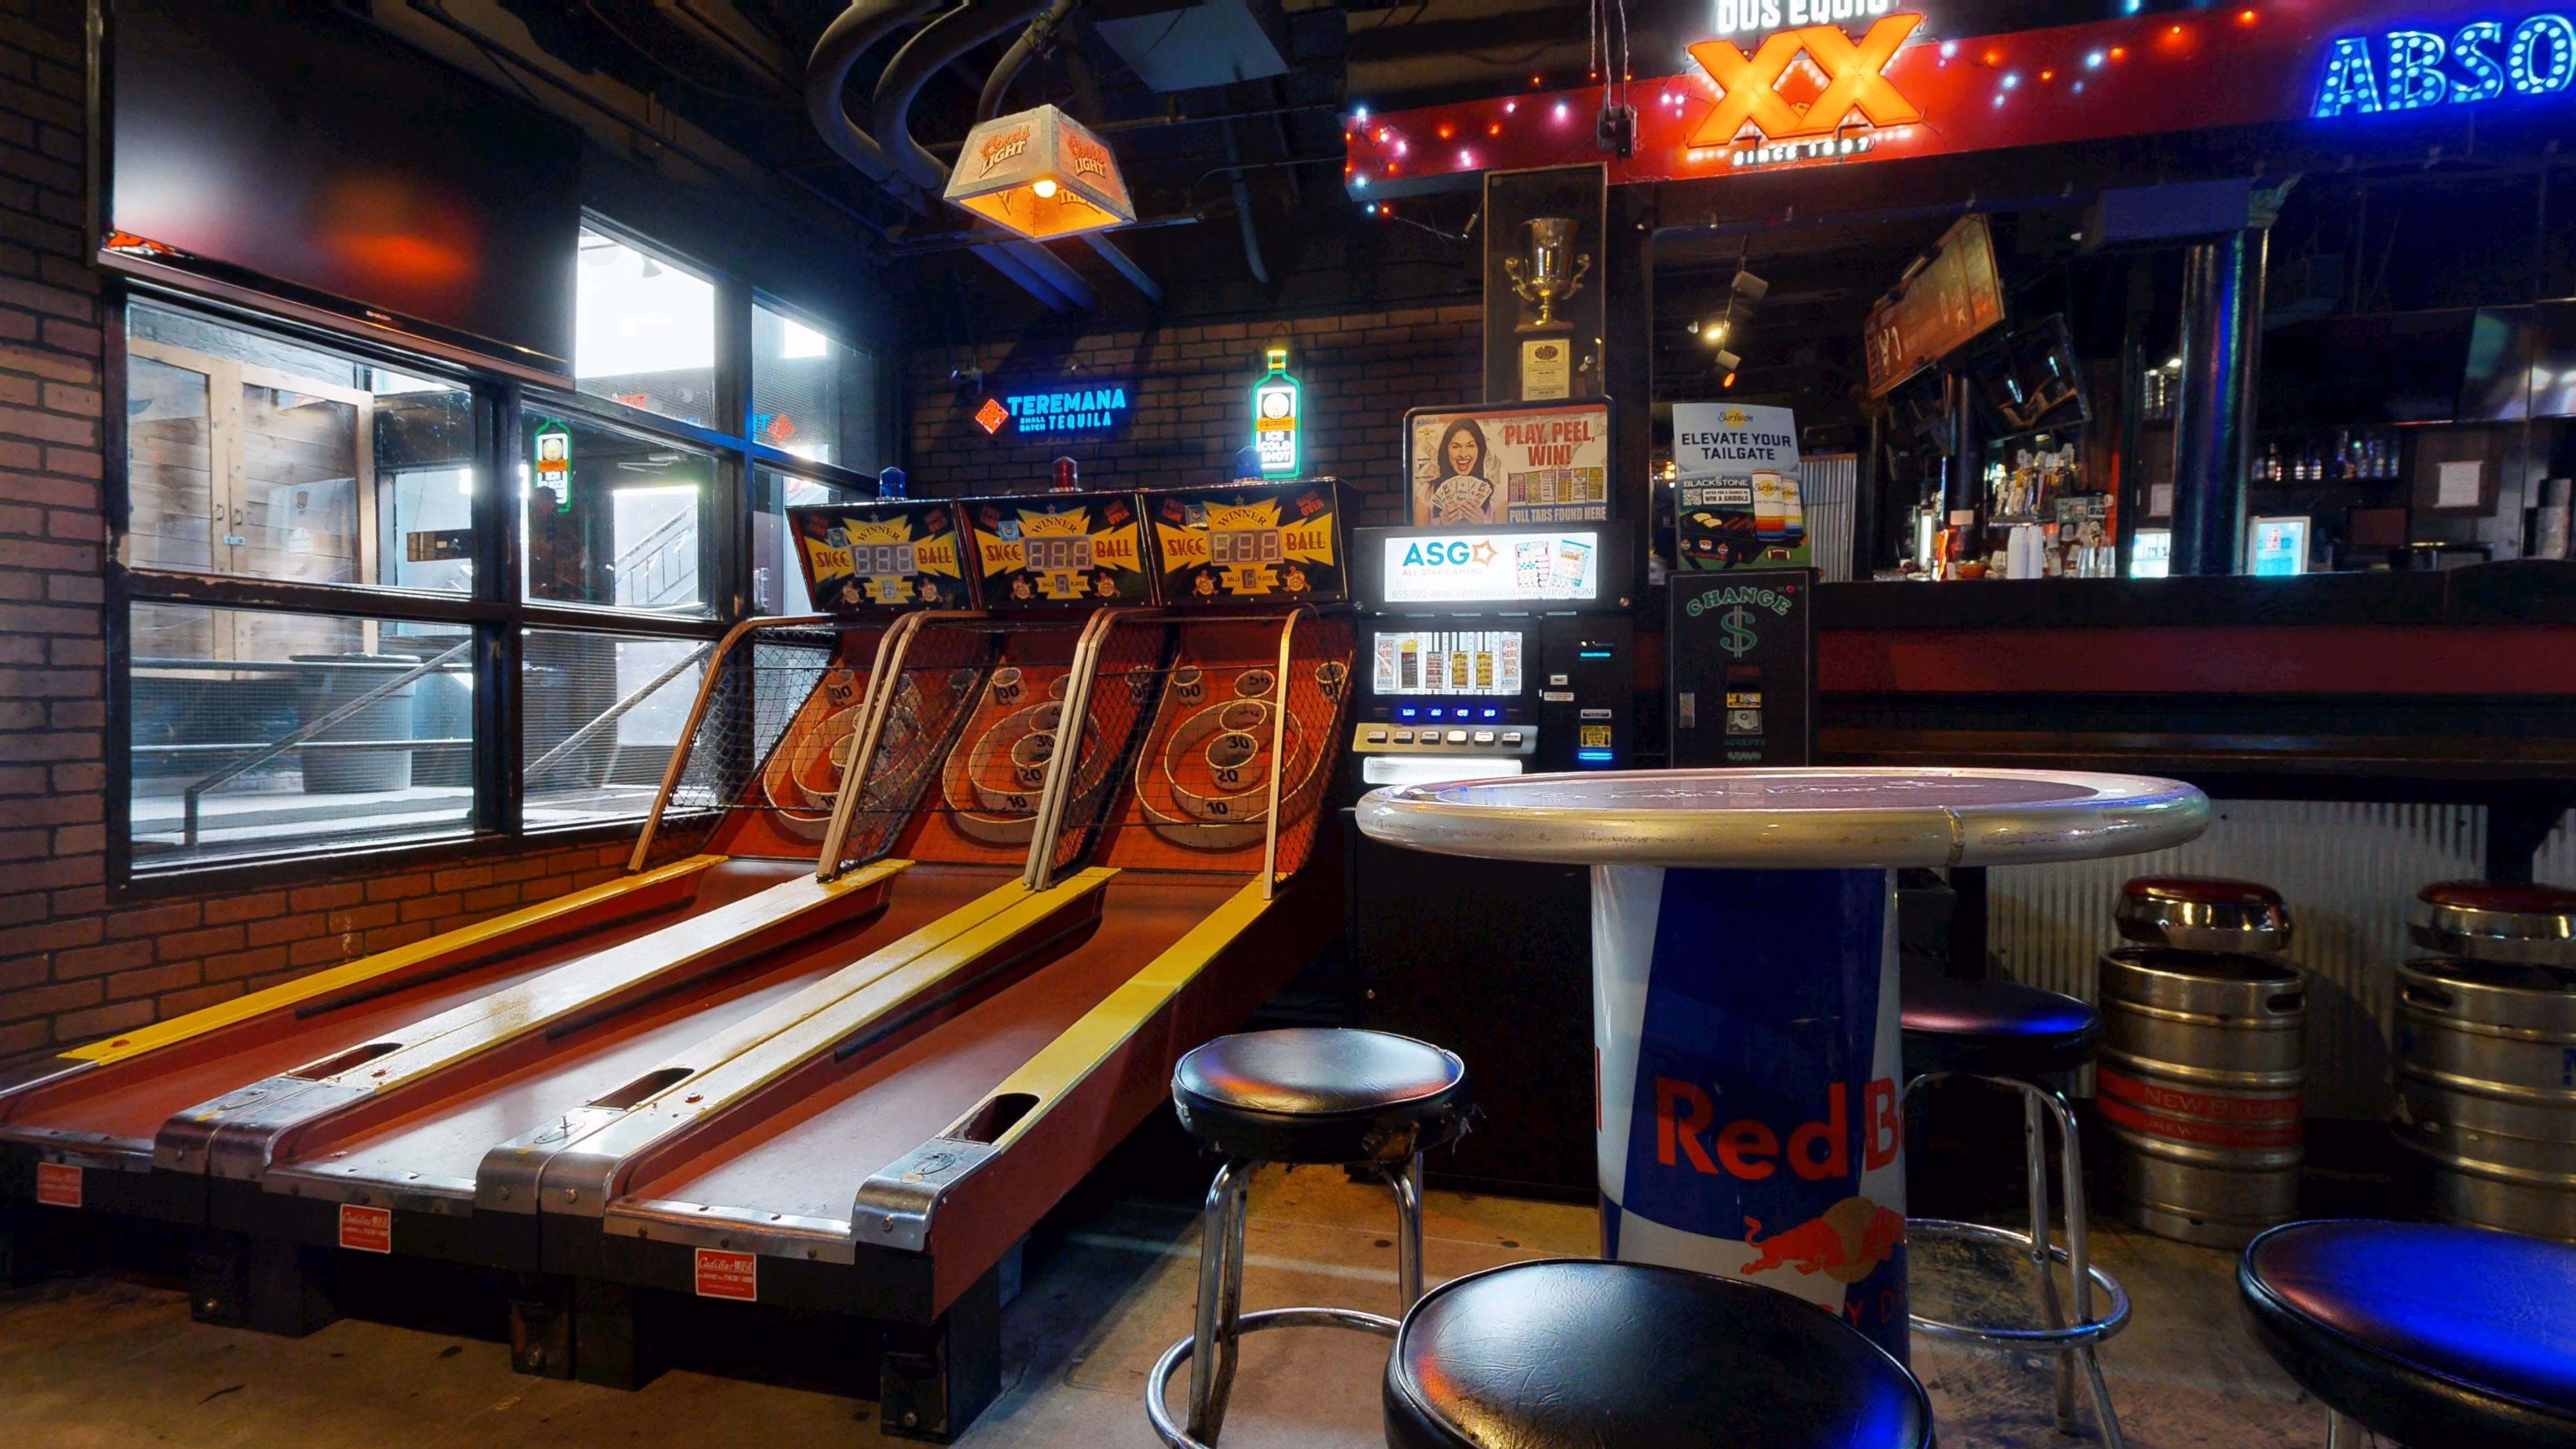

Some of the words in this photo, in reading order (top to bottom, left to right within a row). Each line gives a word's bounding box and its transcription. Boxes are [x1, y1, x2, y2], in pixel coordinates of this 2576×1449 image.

[2313, 13, 2576, 118] ABSO
[1687, 13, 1922, 148] XX
[979, 139, 1027, 178] LIGHT
[1733, 145, 1797, 166] SINCE
[1074, 157, 1106, 178] LIGHT
[1007, 388, 1126, 415] TEREMANA
[1049, 412, 1111, 430] TEQUILA
[1718, 412, 1754, 422] Surfside
[1504, 423, 1547, 445] PLAY,
[1551, 420, 1595, 443] PEEL,
[1681, 433, 1748, 445] ELEVATE
[1752, 434, 1791, 447] YOUR
[1528, 444, 1571, 466] WIN!
[1701, 448, 1775, 460] TAILGATE
[1684, 479, 1748, 488] BLACKSTONE
[1218, 509, 1266, 526] WINNER
[1510, 509, 1529, 522] PULL
[1531, 508, 1553, 521] TABS
[1555, 507, 1583, 520] FOUND
[1584, 506, 1607, 520] HERE
[858, 525, 900, 541] WINNER
[1032, 518, 1077, 534] WINNER
[1095, 539, 1133, 557] BALL
[1167, 537, 1206, 556] SKEE
[1286, 531, 1326, 551] BALL
[815, 551, 850, 568] SKEE
[918, 546, 953, 564] BALL
[985, 544, 1022, 562] SKEE
[1403, 542, 1470, 566] ASG
[1686, 586, 1792, 616] CHANGE
[832, 685, 853, 699] 00
[999, 685, 1020, 699] 00
[1228, 736, 1250, 749] 30
[1021, 768, 1042, 781] 20
[1217, 770, 1239, 783] 20
[1007, 795, 1027, 808] 10
[1207, 802, 1228, 815] 10
[2145, 1087, 2202, 1111] NEW
[1657, 1077, 1849, 1181] Red
[699, 1256, 734, 1270] Cadillac
